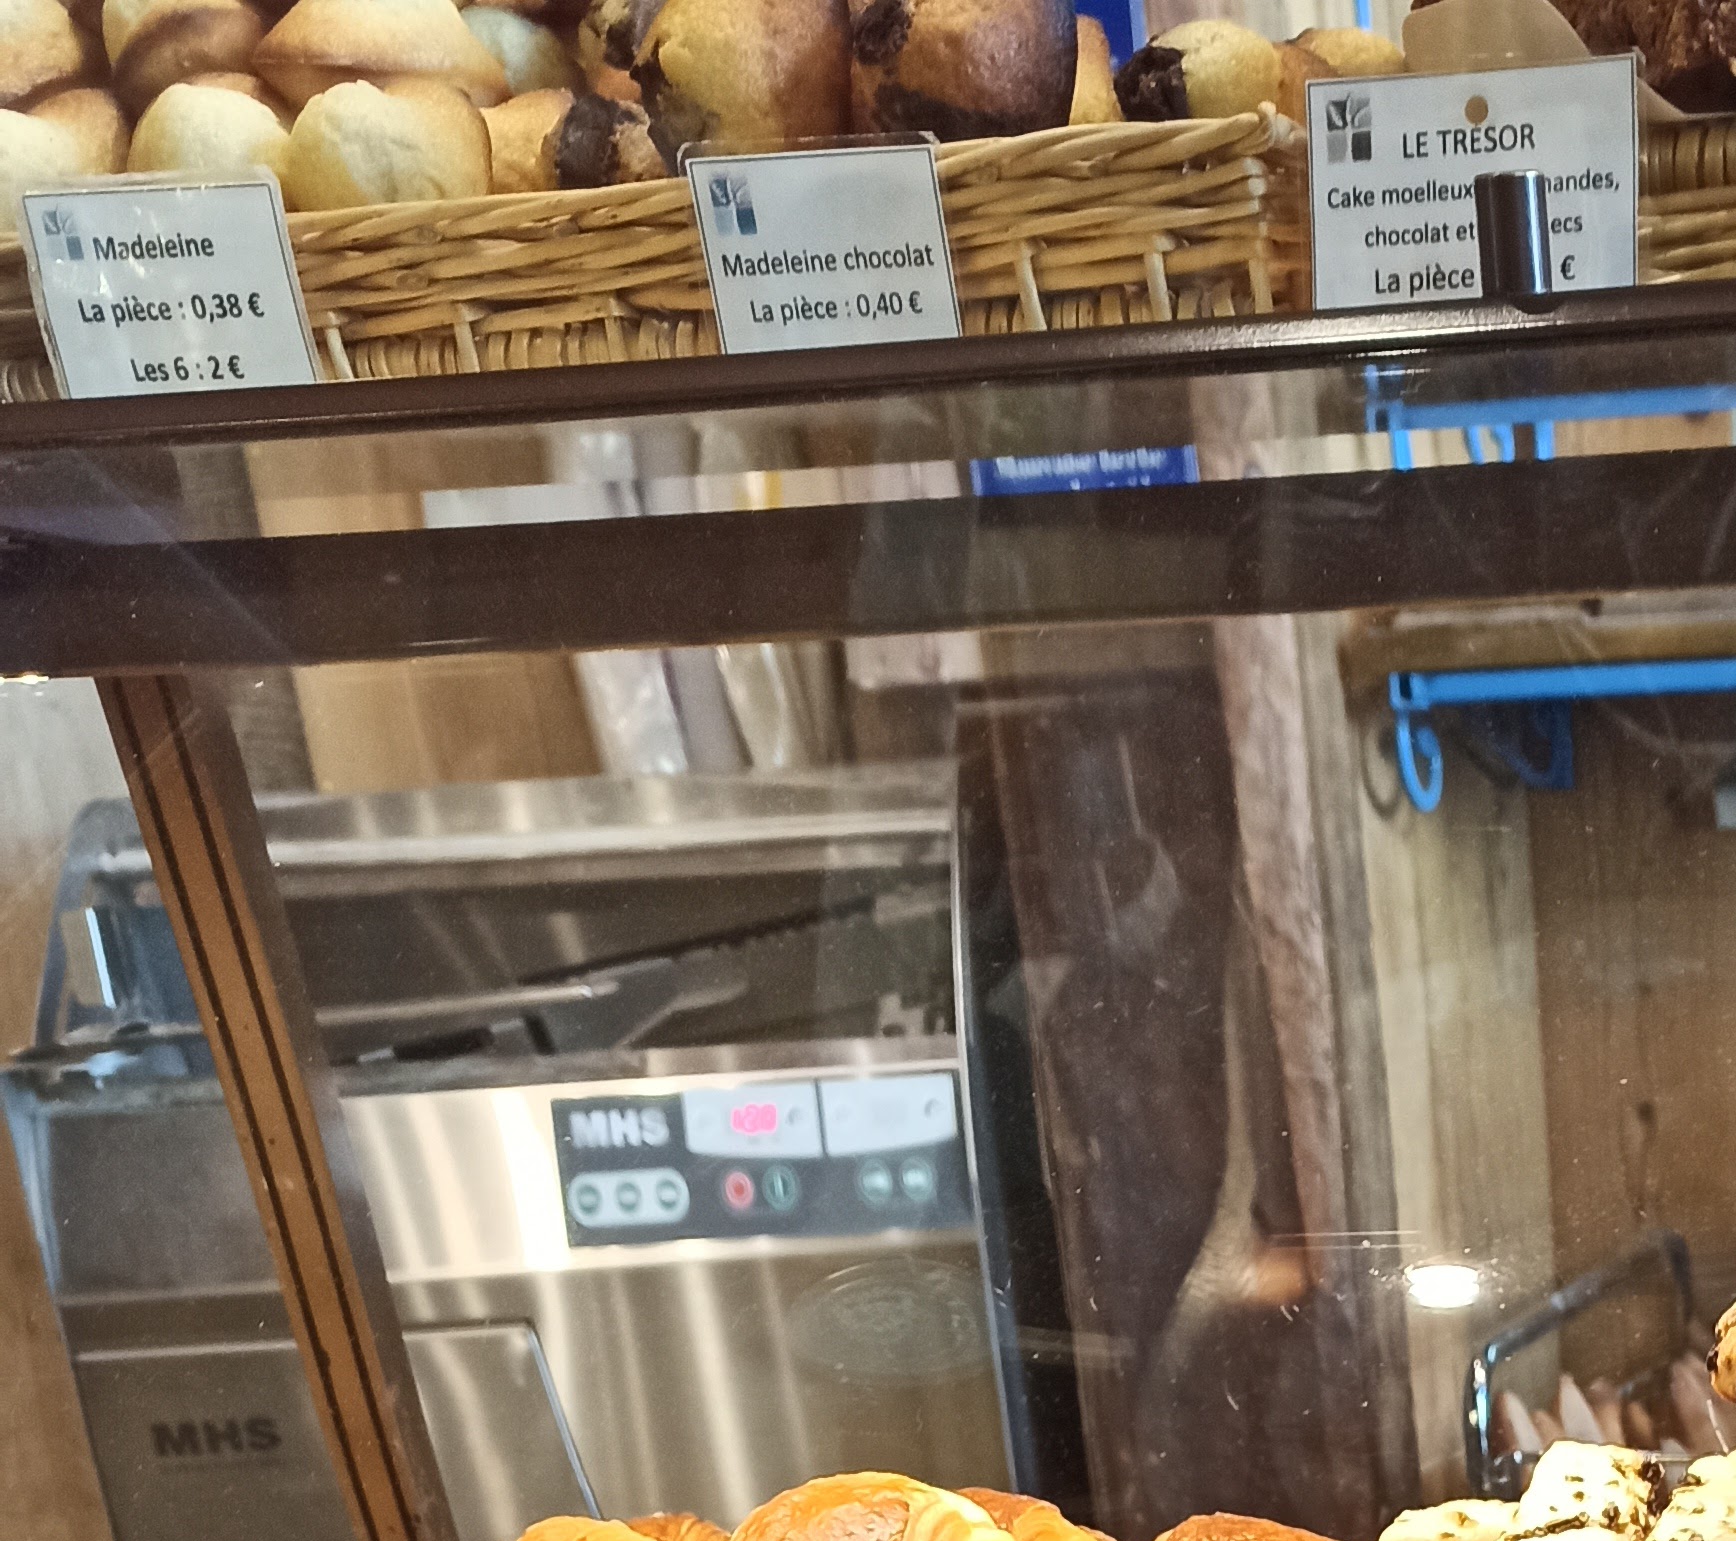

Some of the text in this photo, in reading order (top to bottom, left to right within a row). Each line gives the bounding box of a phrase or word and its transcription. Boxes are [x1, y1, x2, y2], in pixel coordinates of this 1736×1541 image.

[1402, 130, 1429, 159] LE
[1327, 182, 1375, 210] Cake
[1381, 179, 1474, 205] moelleux
[92, 232, 215, 261] Madeleine
[1364, 222, 1449, 248] chocolat
[1456, 220, 1475, 243] et
[721, 241, 935, 277] Madeleine chocolat
[1375, 254, 1576, 298] La pièce €
[78, 298, 105, 323] La
[110, 294, 172, 328] pièce
[191, 292, 243, 323] 0,38
[247, 292, 265, 318] €
[750, 300, 774, 323] La
[780, 296, 838, 327] pièce
[856, 291, 903, 320] 0,40
[909, 290, 923, 314] €
[130, 358, 170, 382] Les
[174, 356, 189, 380] 6
[207, 355, 224, 380] 2
[227, 354, 245, 380] €
[569, 1106, 671, 1149] MHS
[151, 1417, 282, 1457] MHS
